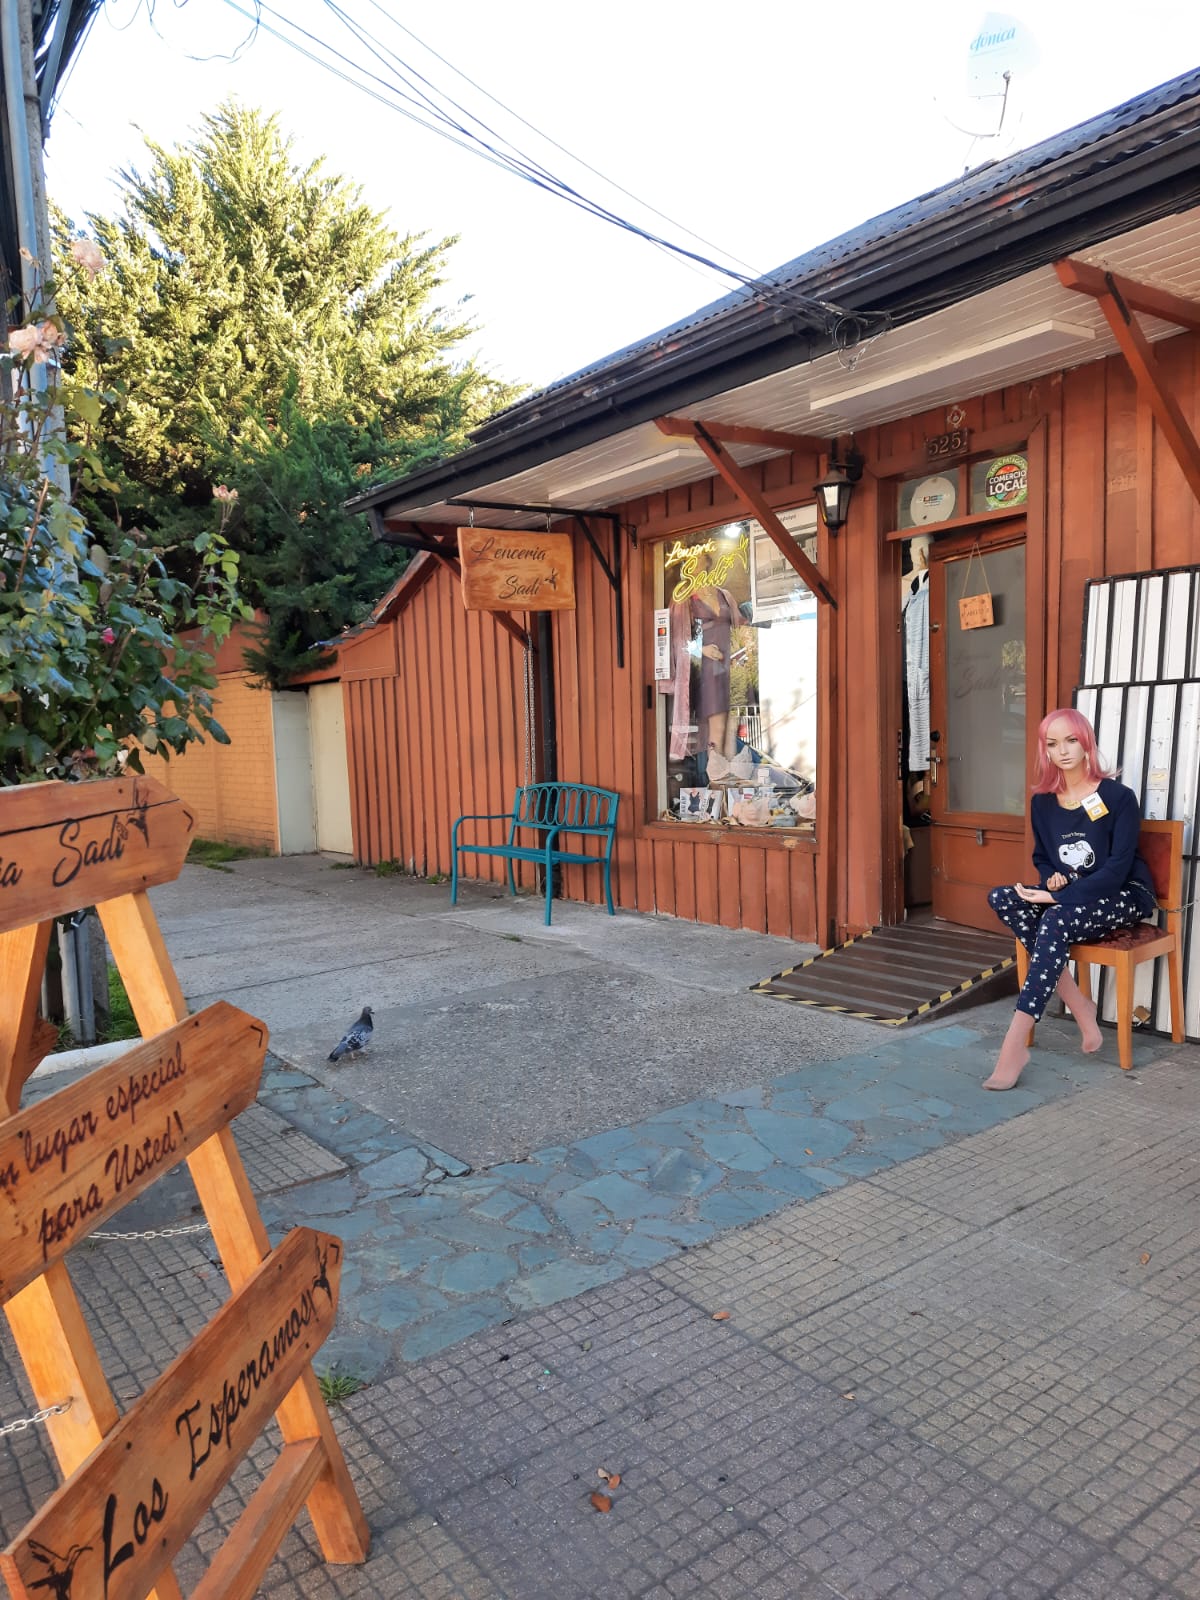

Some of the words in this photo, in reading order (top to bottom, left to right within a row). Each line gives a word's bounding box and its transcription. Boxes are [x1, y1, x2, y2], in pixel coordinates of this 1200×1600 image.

[989, 470, 1027, 484] COMERCIO
[989, 478, 1028, 495] LOCAL
[498, 575, 541, 600] Sadi
[52, 814, 125, 887] Sadi
[23, 1108, 98, 1173] lugar
[106, 1041, 187, 1124] especial
[38, 1183, 103, 1263] para
[104, 1110, 188, 1193] Usted!
[102, 1478, 168, 1600] Los
[175, 1289, 319, 1481] Esperamos!
